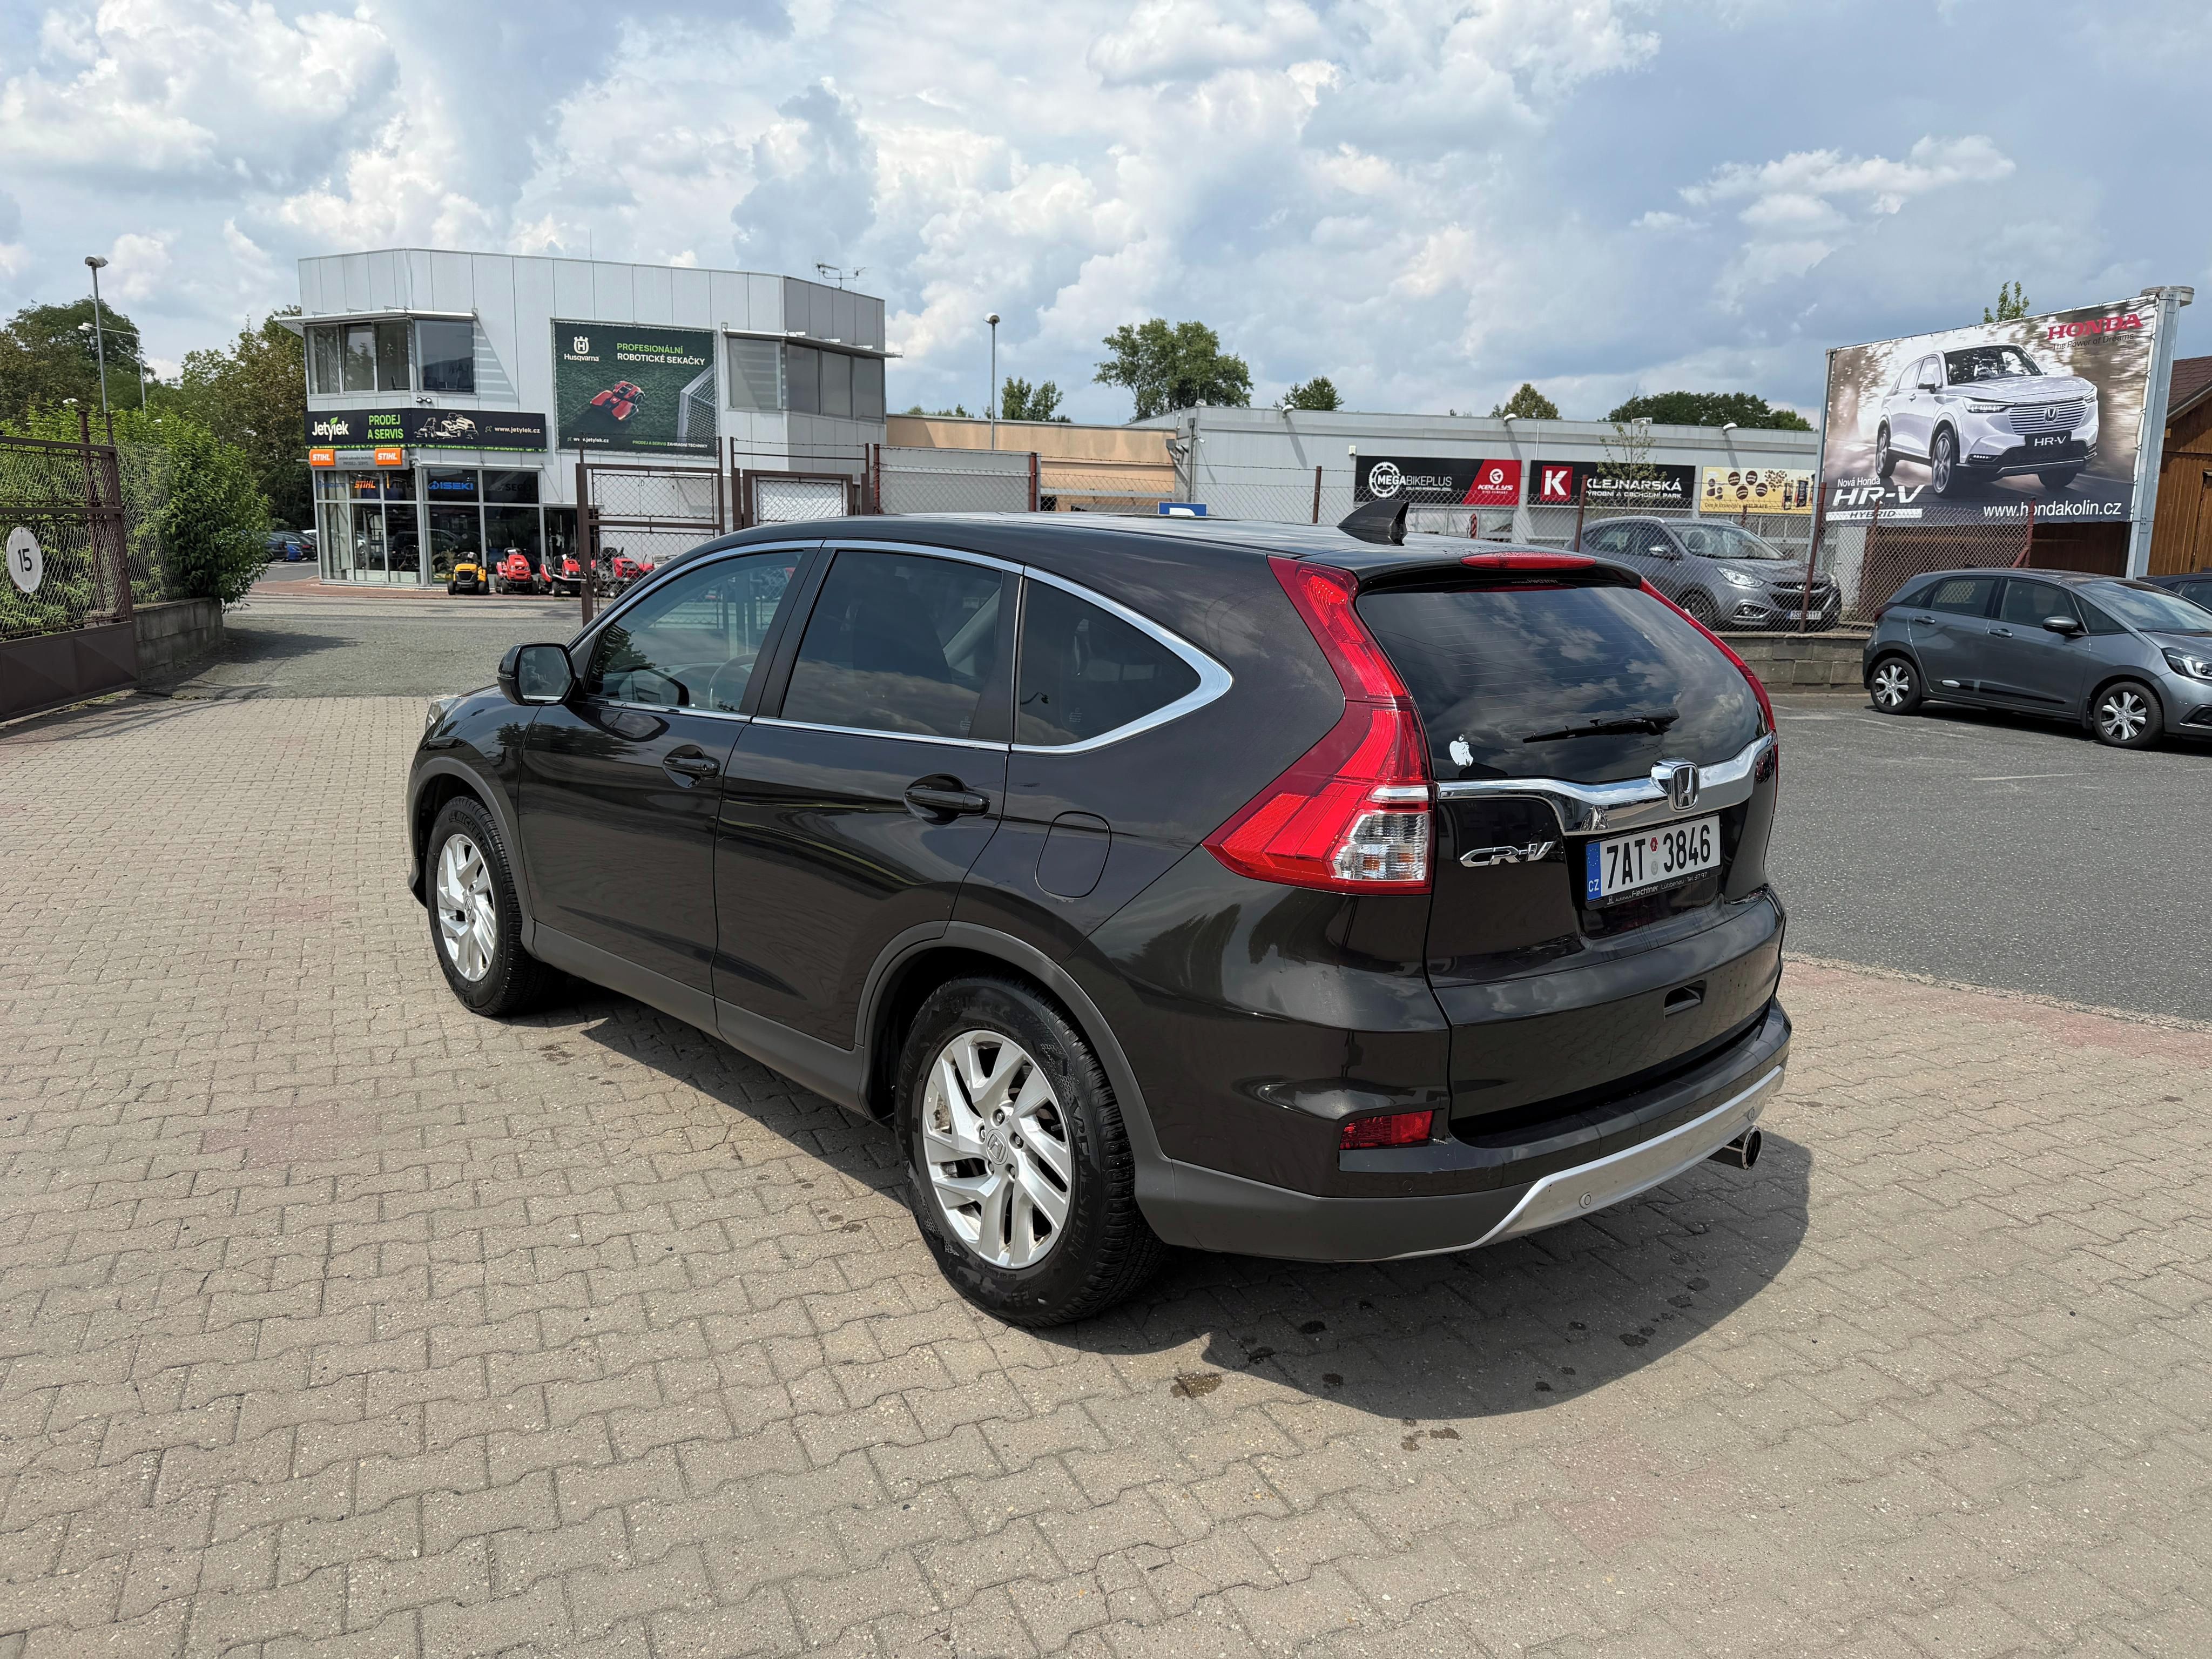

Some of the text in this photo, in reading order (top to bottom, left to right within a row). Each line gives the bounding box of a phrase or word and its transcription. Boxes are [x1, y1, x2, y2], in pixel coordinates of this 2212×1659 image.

[2047, 313, 2143, 340] HONDA
[617, 342, 684, 354] PROFESIONÁLNÍ
[2052, 333, 2134, 351] The Power of Dreams
[564, 353, 599, 362] Husqvarna
[617, 353, 705, 366] ROBOTICKÉ SEKAČKY
[368, 414, 401, 426] PRODEJ
[367, 428, 404, 440] A SERVIS
[494, 424, 541, 434] www.jetylek.cz
[2034, 436, 2066, 447] HR-V
[354, 480, 376, 489] STIHL
[440, 482, 474, 490] ISEKI
[1378, 474, 1452, 487] MEGABIKEPLUS
[1544, 470, 1568, 496] K
[1837, 477, 1880, 487] Nová Honda
[1832, 484, 1925, 506] HR-V
[17, 548, 32, 572] 15
[1459, 841, 1555, 867] CR-V
[1607, 824, 1711, 889] 7AT 3846
[1588, 879, 1599, 892] CZ
